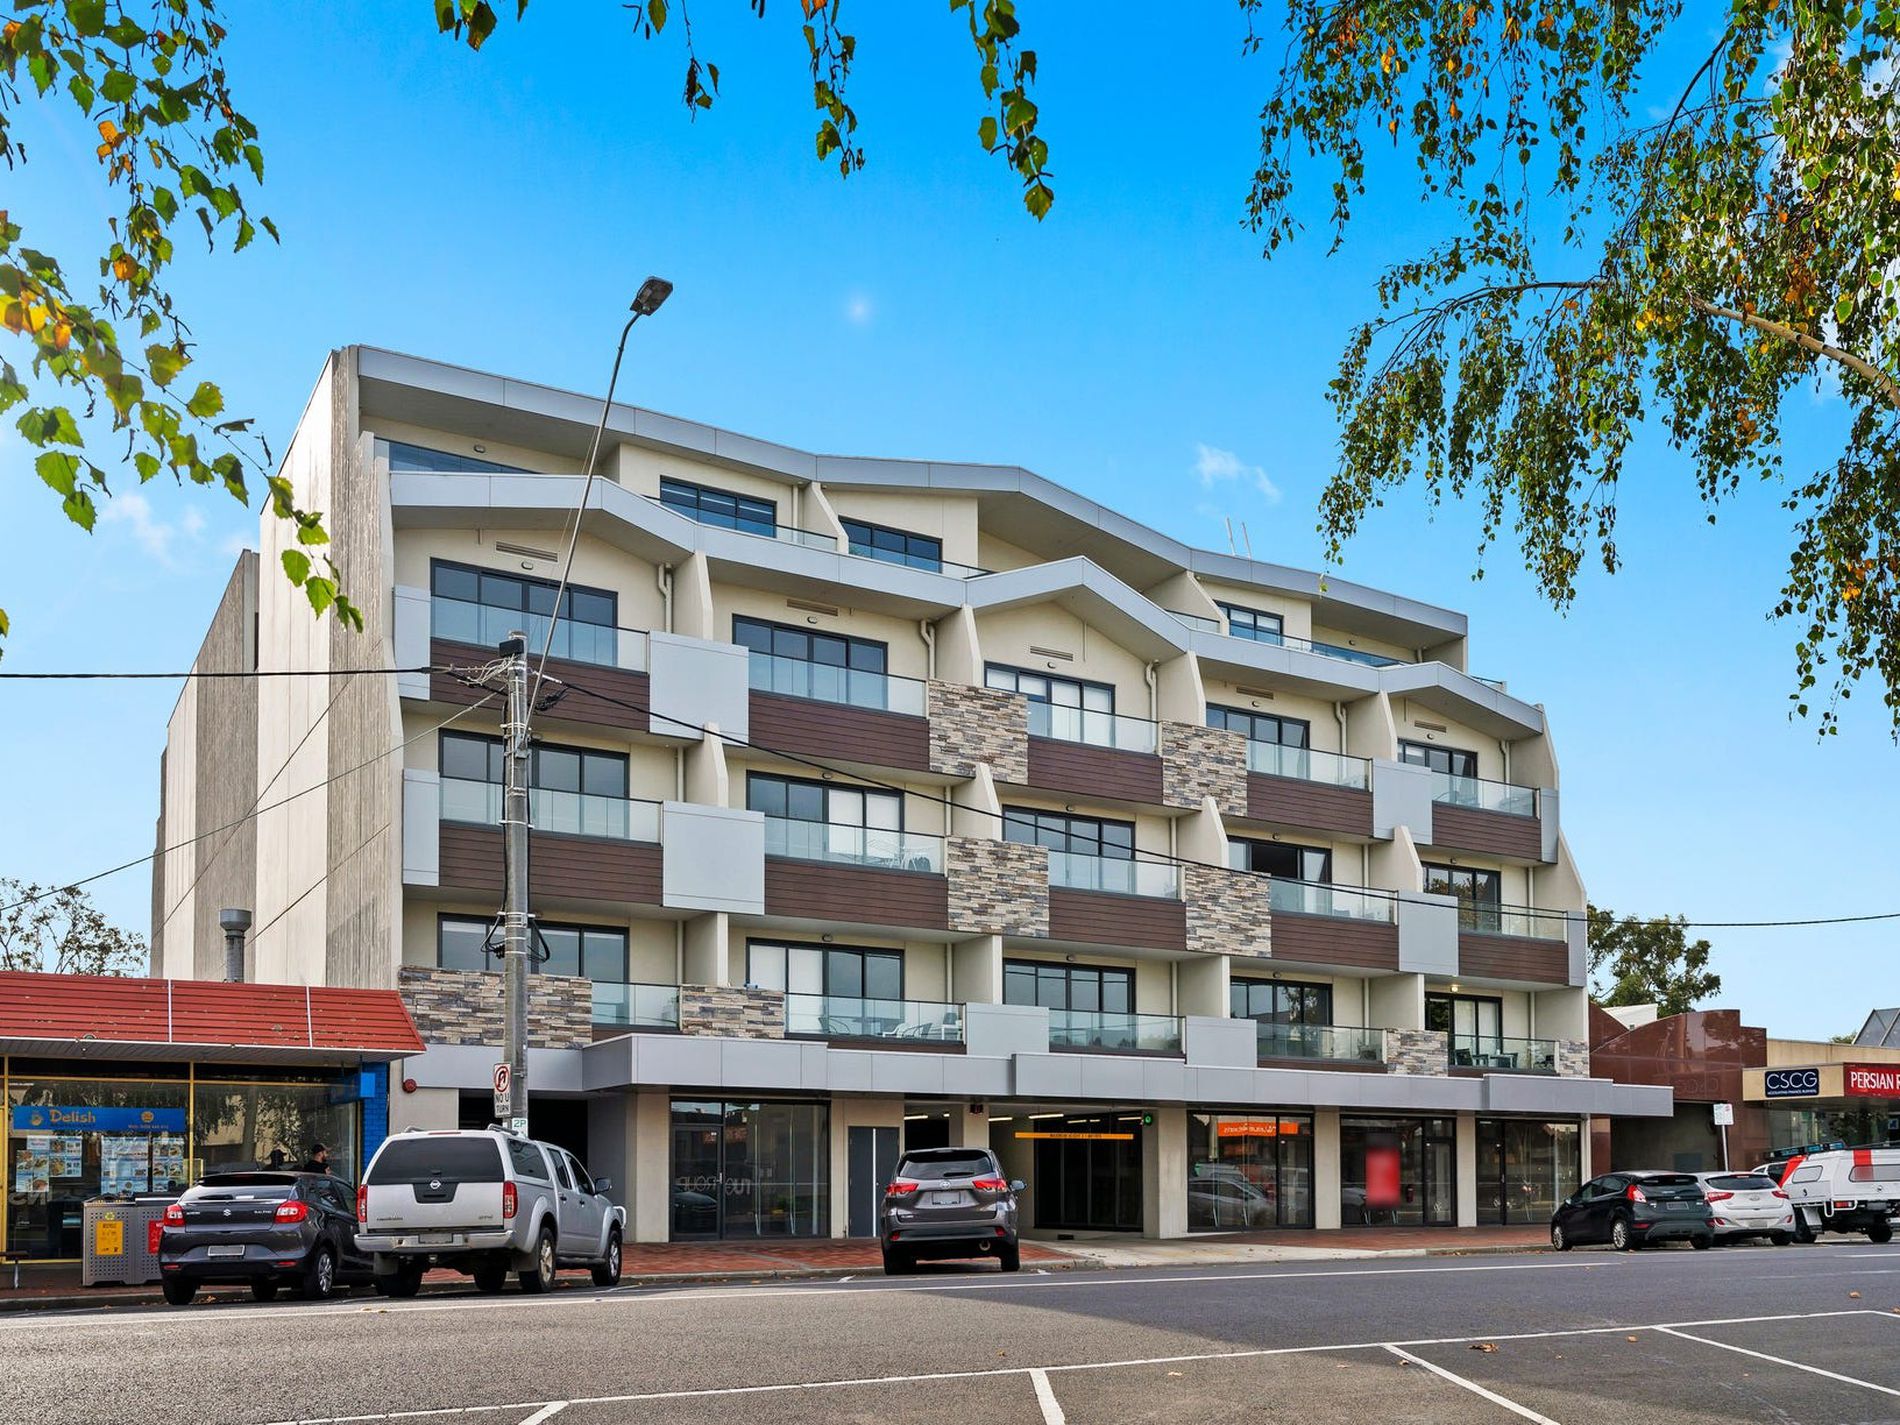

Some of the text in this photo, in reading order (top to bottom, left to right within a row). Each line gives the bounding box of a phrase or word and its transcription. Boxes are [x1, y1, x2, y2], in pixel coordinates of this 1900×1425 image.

[1767, 1071, 1817, 1089] CSCG
[1850, 1071, 1894, 1089] PERSIAN
[495, 1093, 504, 1103] NO
[496, 1104, 510, 1114] TURN
[49, 1109, 97, 1123] Delish
[513, 1119, 527, 1128] 2P
